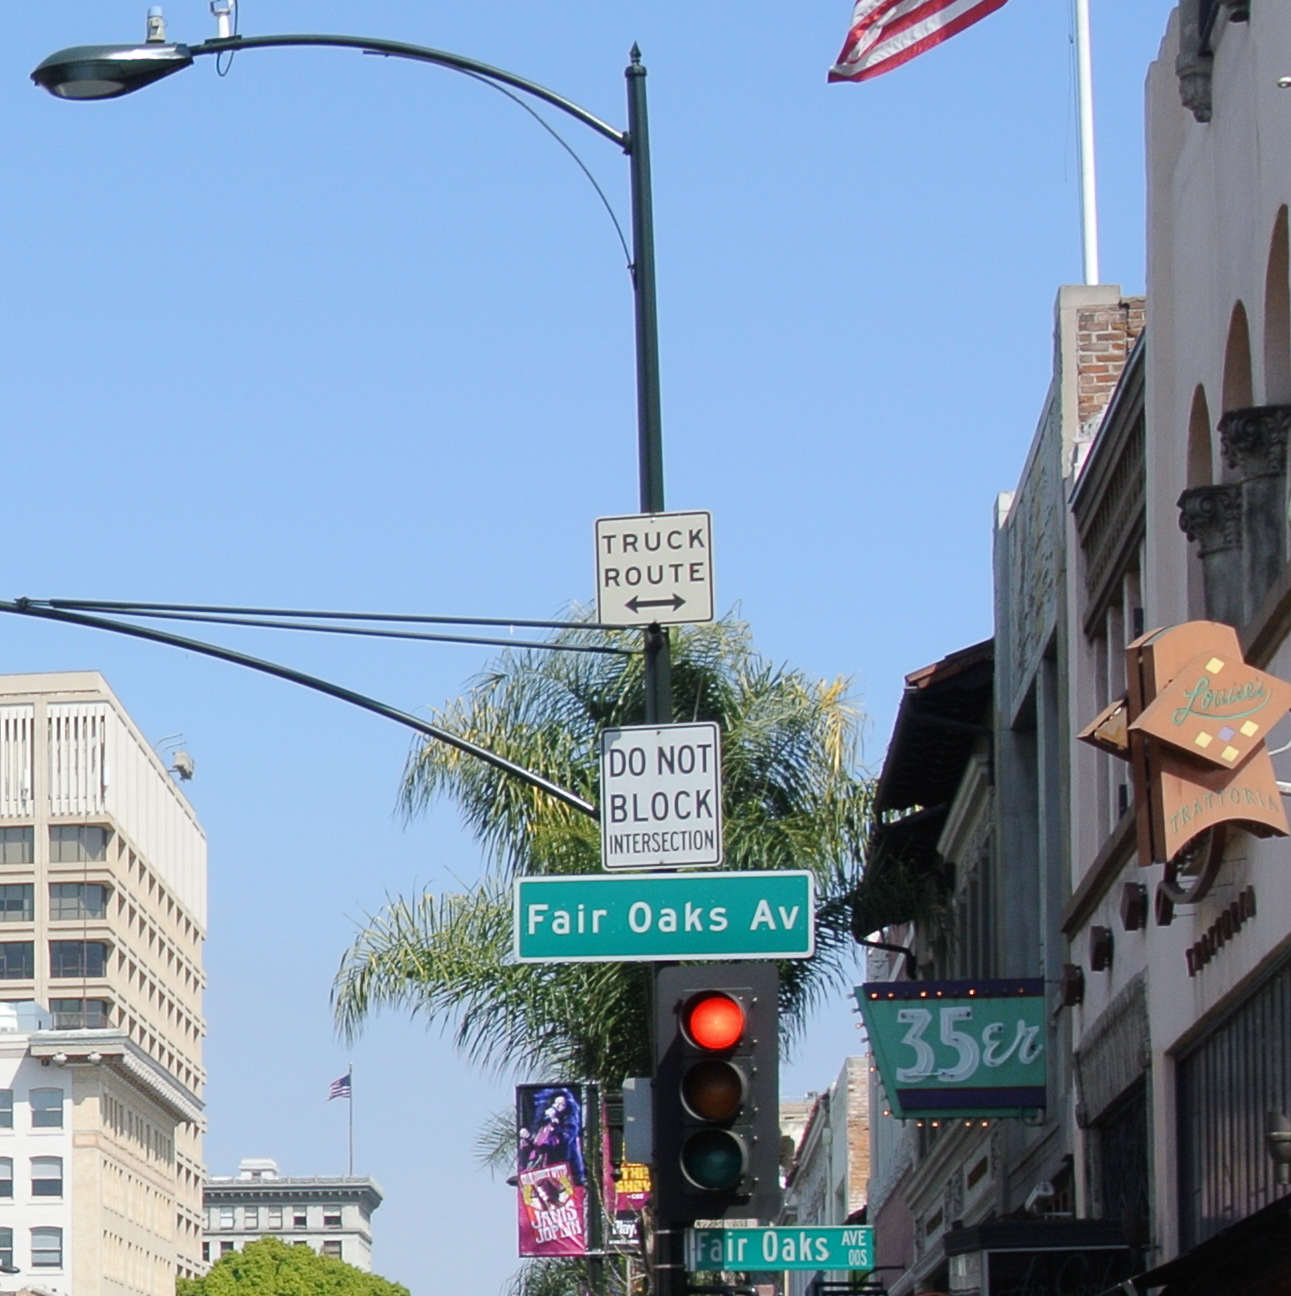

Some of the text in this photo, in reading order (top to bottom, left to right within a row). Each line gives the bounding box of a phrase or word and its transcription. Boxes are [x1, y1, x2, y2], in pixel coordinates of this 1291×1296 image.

[602, 528, 705, 554] TRUCK
[604, 562, 705, 587] ROUTE
[1172, 676, 1271, 725] Louise's
[609, 743, 712, 778] DO NOT
[610, 789, 713, 823] BLOCK
[1169, 788, 1280, 834] TRATTORIA
[610, 829, 714, 854] INTERSECTION
[528, 899, 800, 935] Fair Oaks Av
[896, 1006, 1044, 1083] 35er
[531, 1200, 578, 1229] JANIS
[535, 1220, 583, 1244] JOPLIN
[696, 1230, 867, 1262] Fair Oaks AVE
